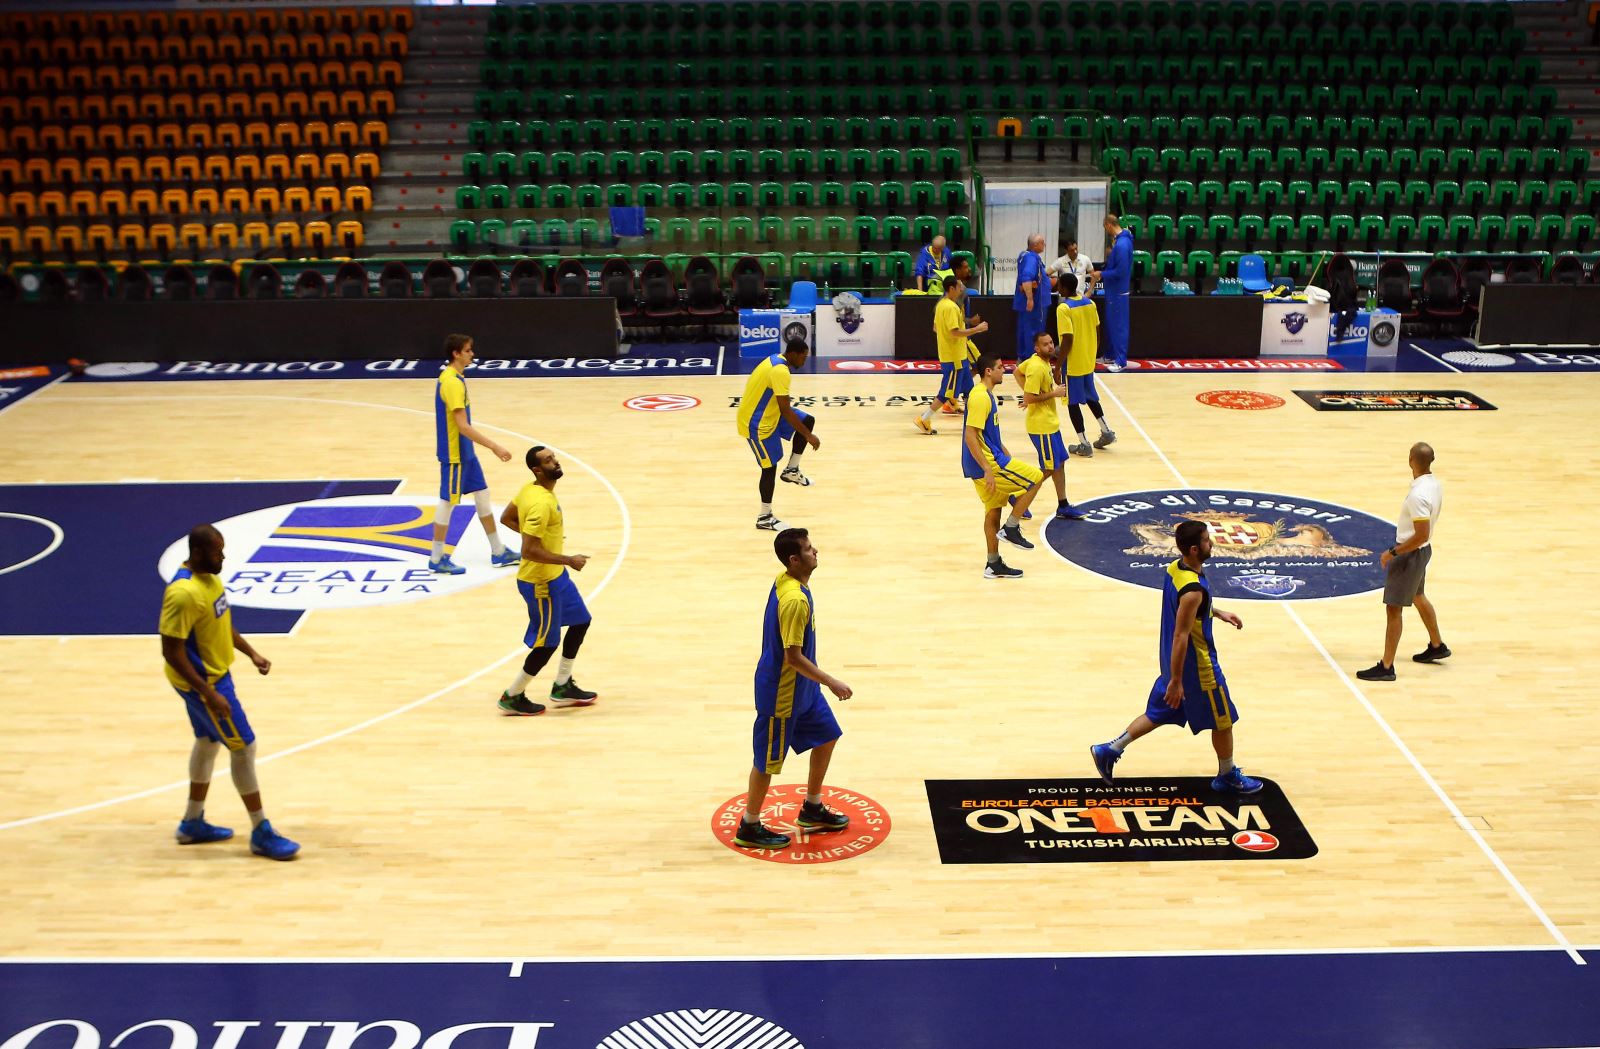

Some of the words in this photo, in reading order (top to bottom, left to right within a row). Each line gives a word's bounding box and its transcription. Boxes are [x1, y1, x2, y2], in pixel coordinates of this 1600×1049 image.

[740, 324, 780, 338] beko
[164, 360, 345, 374] Banco
[364, 359, 420, 371] di
[1149, 359, 1331, 370] Meridiana
[1160, 494, 1197, 506] di
[1208, 494, 1352, 523] Sassari
[227, 568, 439, 583] REALE
[224, 583, 432, 594] MUTUA
[1028, 787, 1080, 795] PROUD
[1085, 785, 1157, 794] PARTNER
[794, 786, 884, 827] OYMPICS
[961, 799, 1079, 808] EUROLEAGUE
[1085, 797, 1204, 807] BASKETBALL
[789, 834, 875, 861] UNIFIED
[1024, 837, 1124, 849] TURKISH
[1127, 836, 1231, 848] AIRLINES
